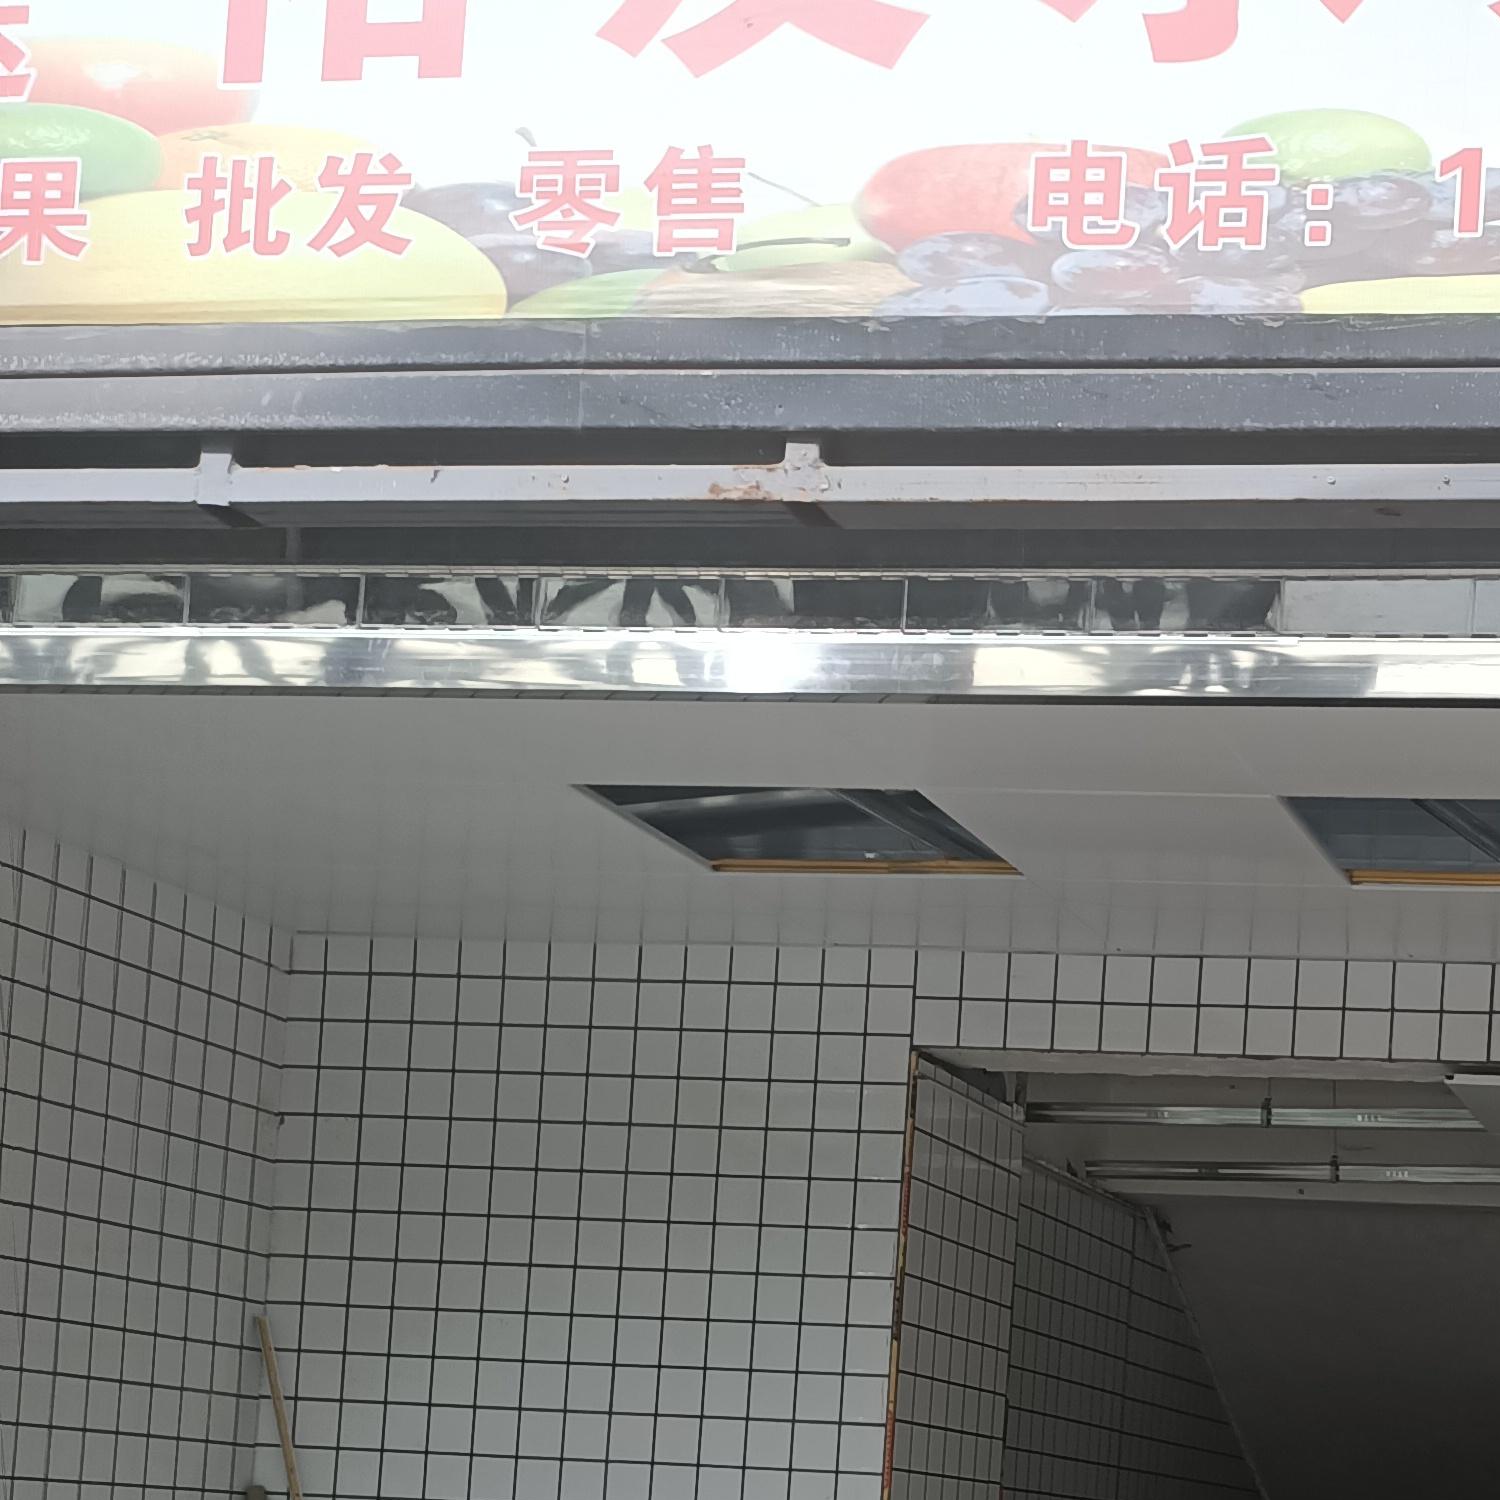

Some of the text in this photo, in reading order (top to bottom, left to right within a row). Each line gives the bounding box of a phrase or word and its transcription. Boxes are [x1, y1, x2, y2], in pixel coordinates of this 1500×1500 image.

[0, 161, 88, 262] 果
[185, 152, 413, 258] 批发
[512, 143, 746, 254] 零售
